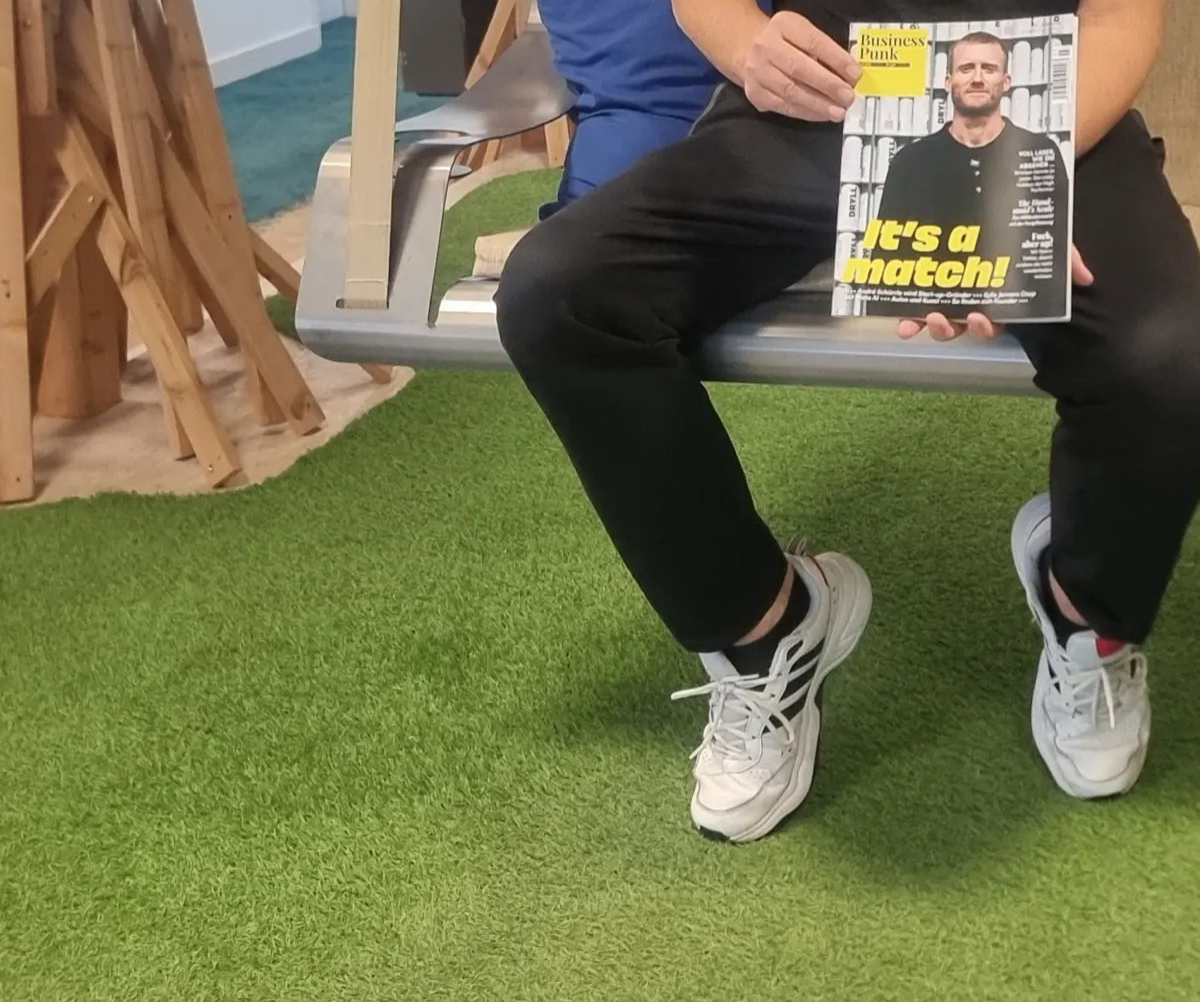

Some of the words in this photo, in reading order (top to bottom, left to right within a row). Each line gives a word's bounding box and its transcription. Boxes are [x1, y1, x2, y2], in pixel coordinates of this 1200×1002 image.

[859, 46, 899, 60] Punk
[860, 33, 926, 47] Business
[849, 186, 858, 218] DRYLL
[863, 219, 942, 252] It's
[948, 224, 981, 253] a
[841, 255, 1011, 289] match!
